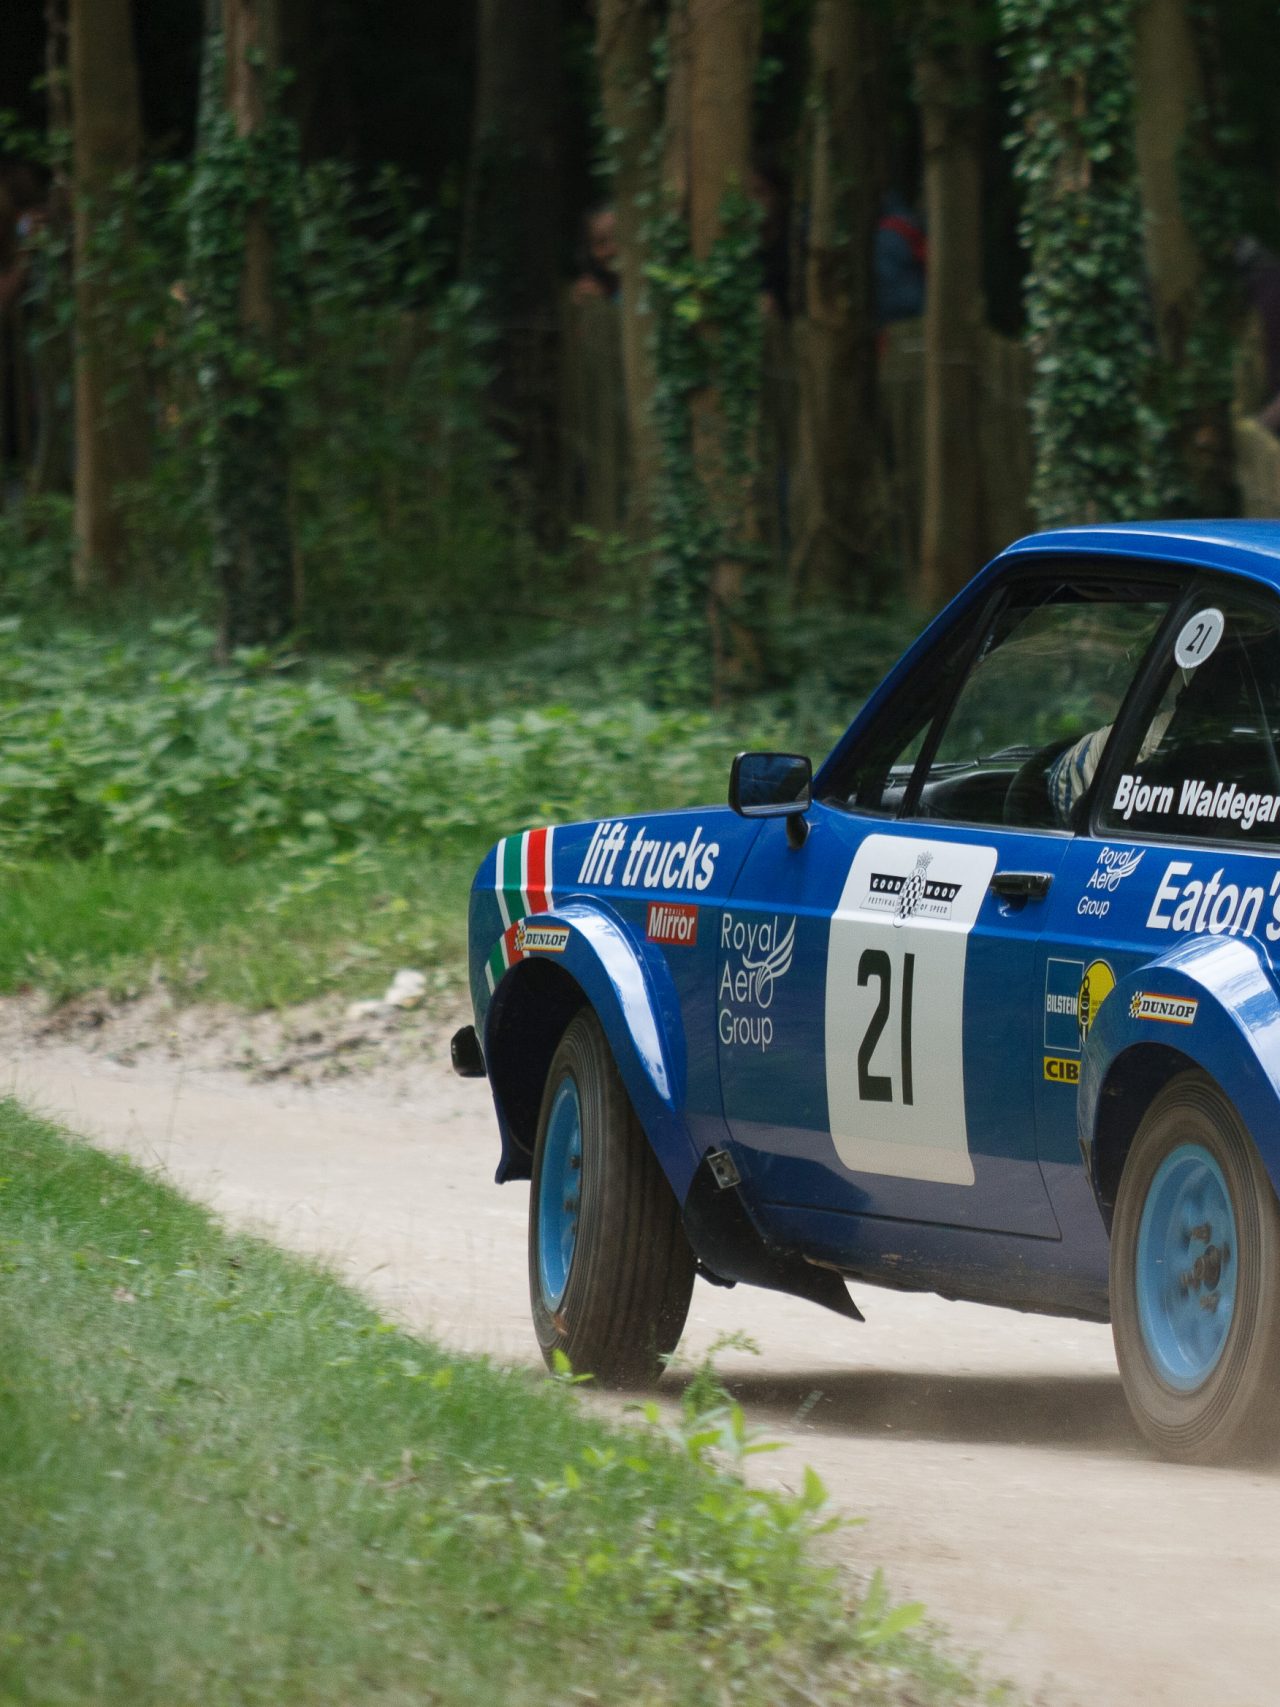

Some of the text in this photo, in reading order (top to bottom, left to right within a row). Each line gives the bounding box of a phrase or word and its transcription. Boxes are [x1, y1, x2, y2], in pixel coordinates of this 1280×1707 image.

[1185, 623, 1212, 654] 21
[1113, 774, 1174, 820] Bjorn
[577, 822, 720, 891] lift trucks
[1096, 846, 1134, 870] Royal
[648, 906, 696, 940] Mirror
[1076, 895, 1110, 919] Group
[525, 930, 568, 946] DUNLOP
[720, 913, 778, 956] Royal
[1046, 994, 1079, 1016] BILSTEIN
[1142, 1000, 1196, 1019] DUNLOP
[719, 1008, 774, 1052] Group
[857, 948, 916, 1106] 21
